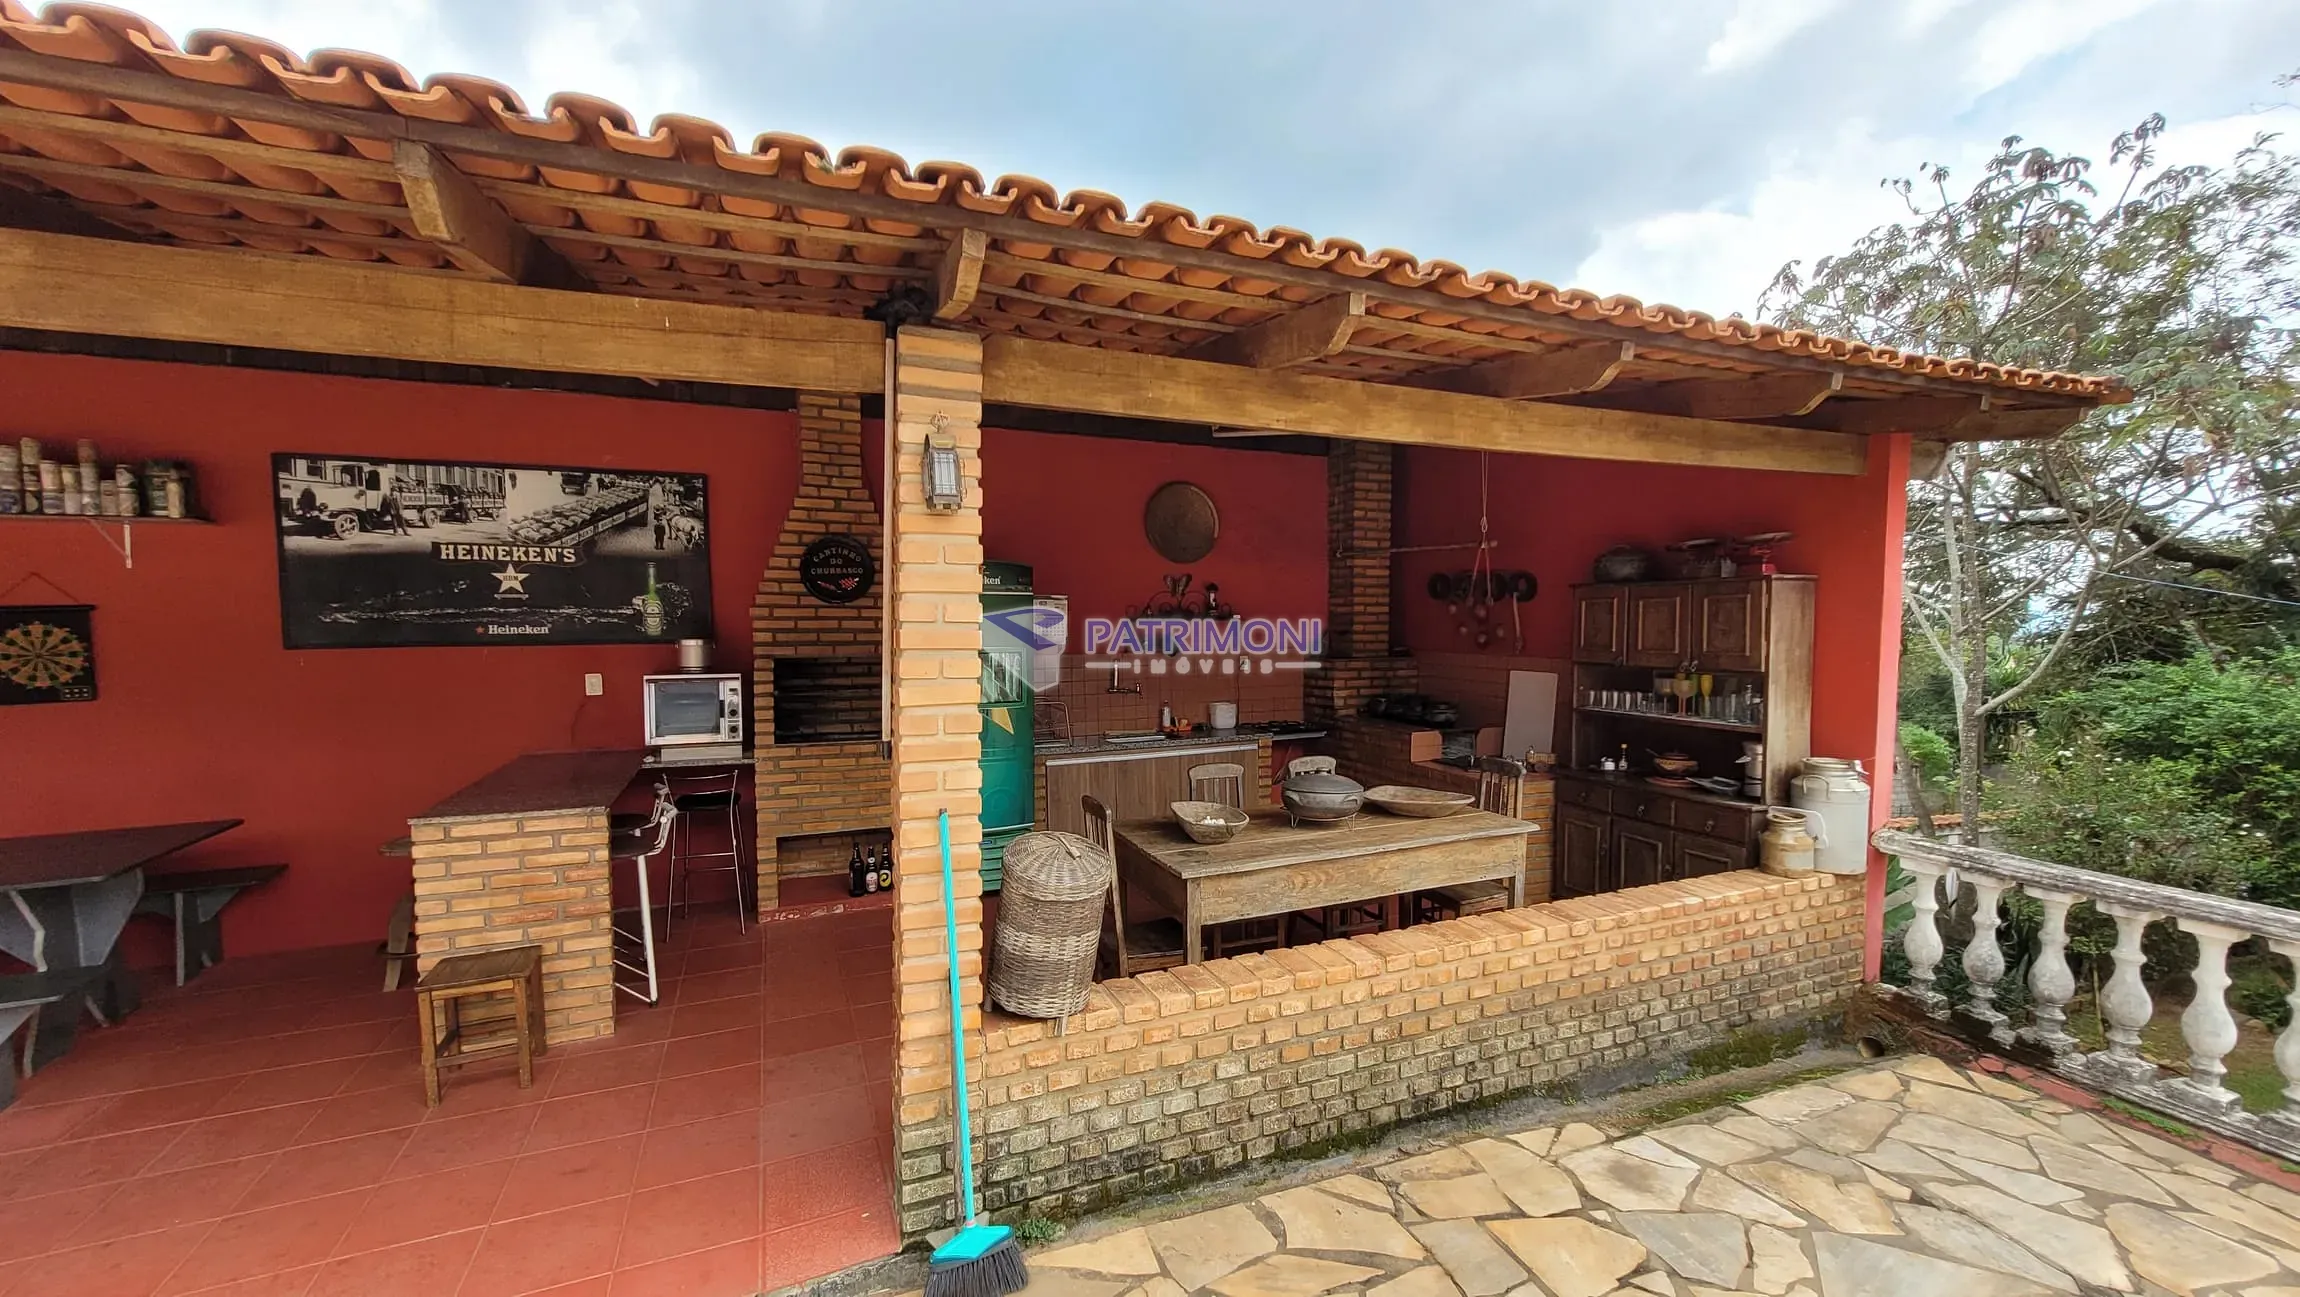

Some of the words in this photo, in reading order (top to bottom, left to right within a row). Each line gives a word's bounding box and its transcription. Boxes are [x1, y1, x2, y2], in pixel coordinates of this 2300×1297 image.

[440, 544, 577, 562] HEINEKEN'S
[813, 547, 862, 562] CANTINHO
[811, 567, 864, 575] CHURRASCO
[488, 624, 549, 635] Heineken
